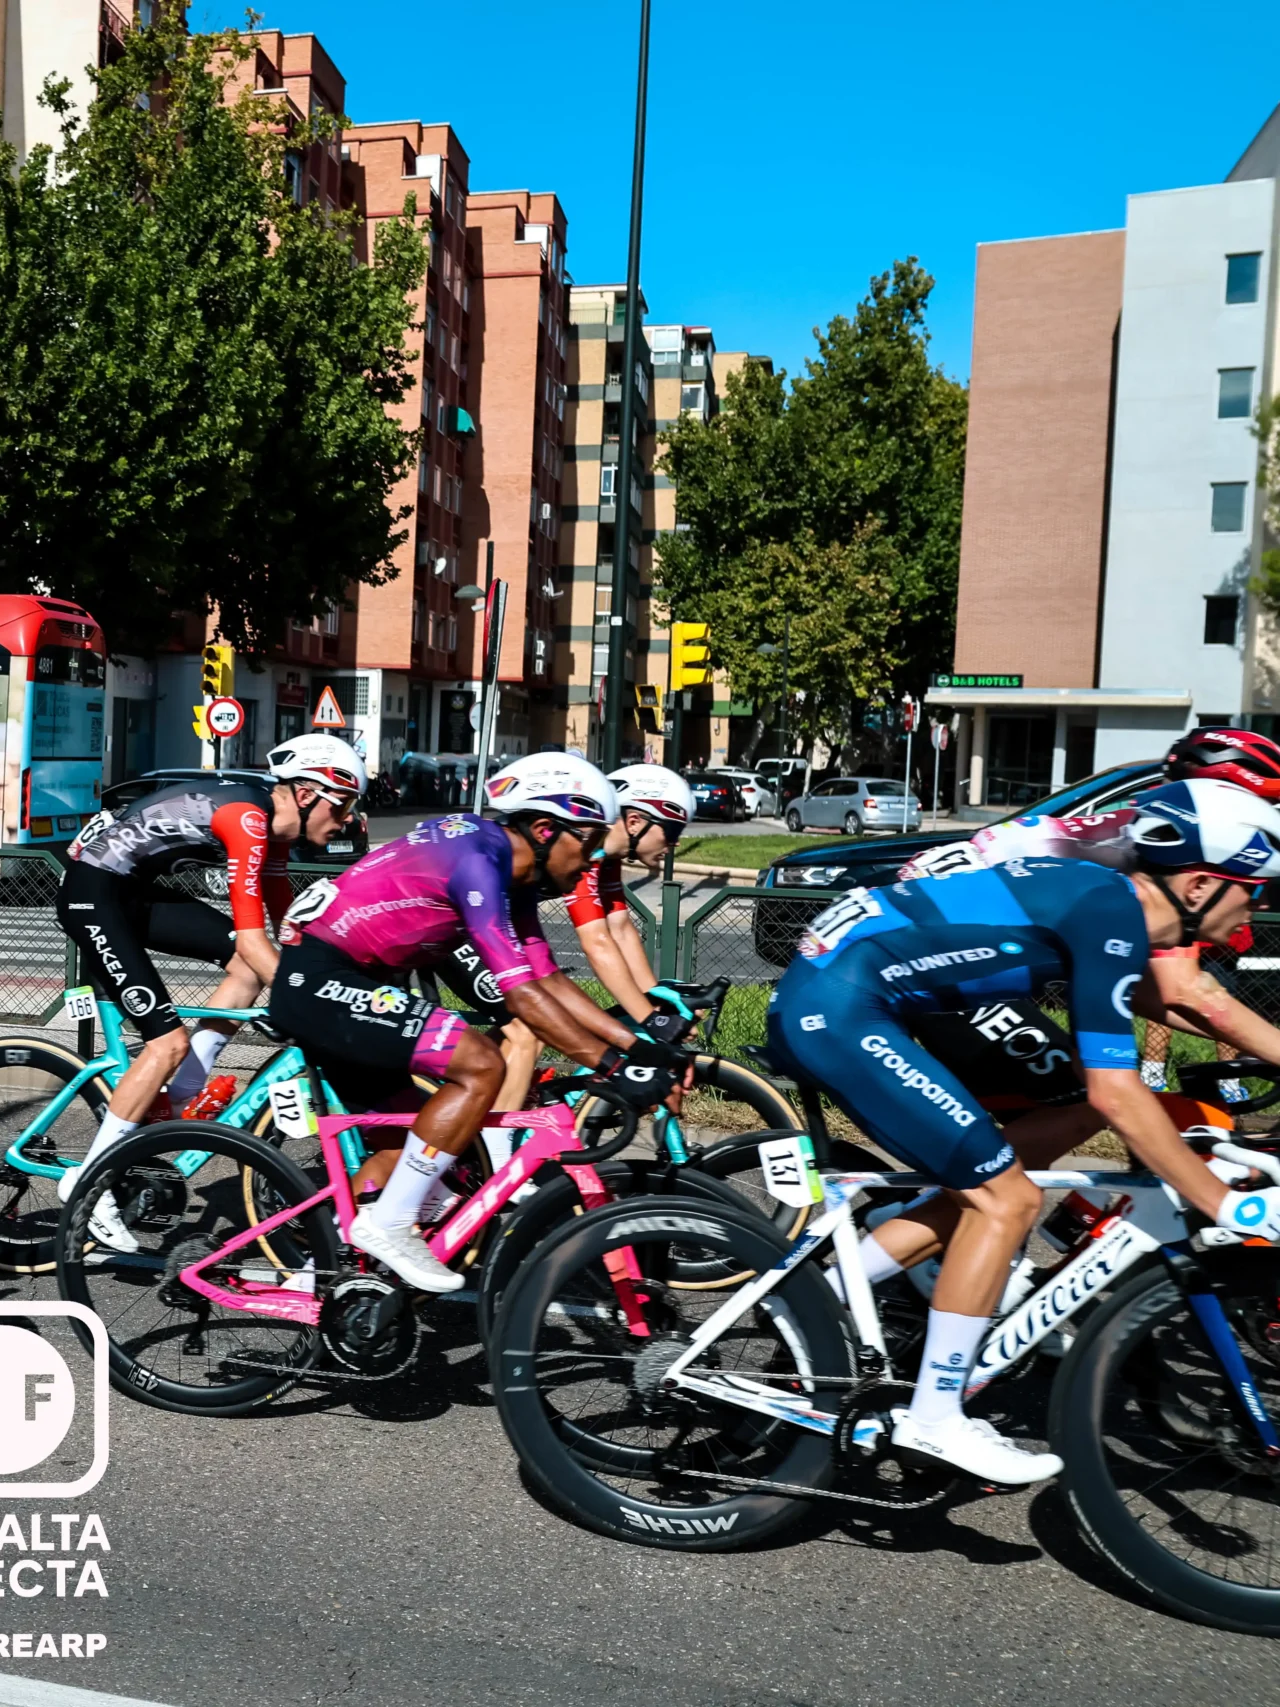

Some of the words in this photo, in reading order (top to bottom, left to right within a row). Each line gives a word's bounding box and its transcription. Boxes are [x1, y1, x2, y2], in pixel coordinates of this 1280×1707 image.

[952, 676, 976, 686] B&B
[977, 676, 1020, 686] HOTELS
[107, 817, 205, 862] ARKEA
[245, 845, 264, 897] ARKEA
[84, 924, 129, 987] ARKEA
[910, 947, 998, 973] UNITED
[68, 996, 93, 1017] 166
[314, 980, 410, 1014] Burgos
[860, 1034, 977, 1128] Groupama
[273, 1089, 301, 1124] 212
[767, 1150, 803, 1186] 137
[606, 1216, 731, 1242] MICHE
[620, 1505, 740, 1536] MICHE
